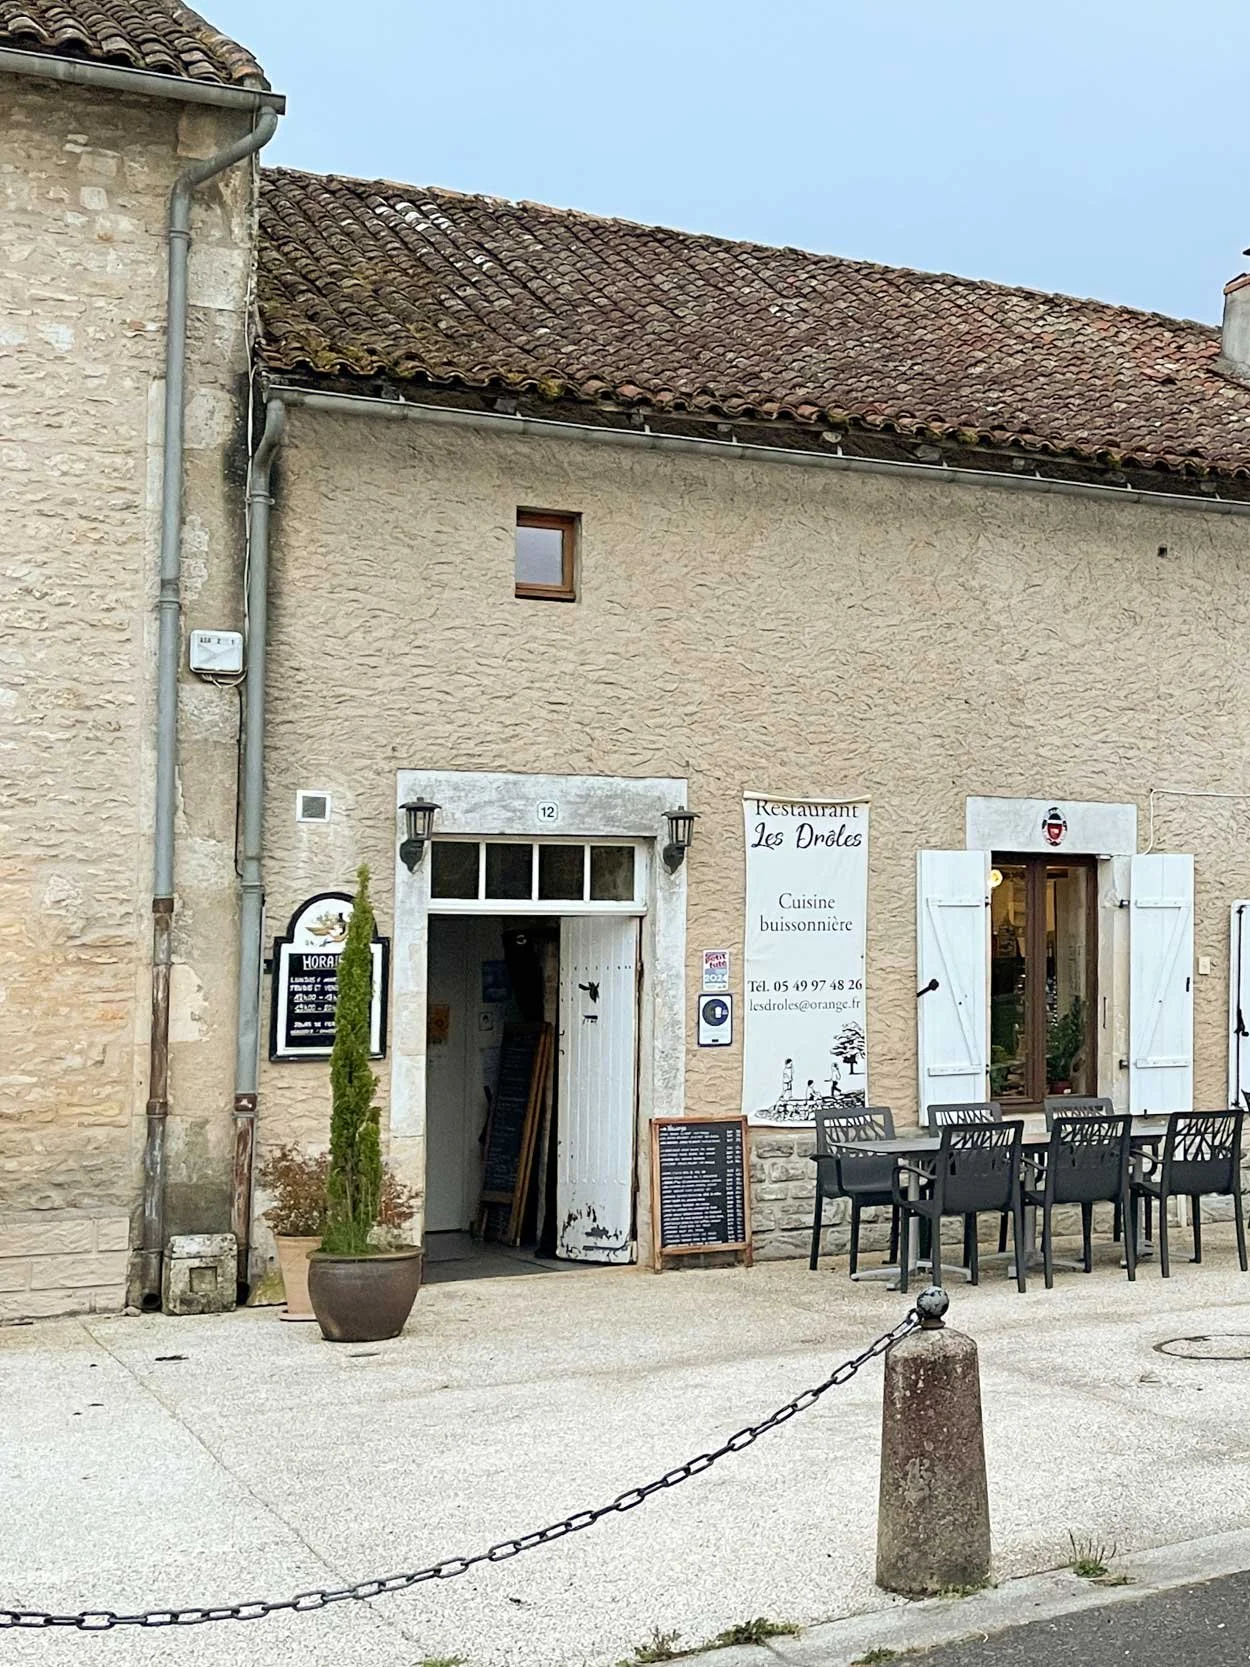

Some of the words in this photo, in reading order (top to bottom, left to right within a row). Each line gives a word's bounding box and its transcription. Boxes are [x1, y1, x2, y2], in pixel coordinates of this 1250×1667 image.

[541, 806, 555, 818] 12
[755, 799, 859, 818] Restaurant
[751, 822, 784, 850] Les
[796, 823, 863, 849] Drôles
[778, 892, 836, 909] Cuisine
[760, 914, 853, 932] buissonnière
[302, 955, 344, 969] HORAI
[747, 980, 770, 992] Tél.
[773, 980, 789, 992] 05
[792, 980, 808, 992] 49
[811, 980, 827, 991] 97
[829, 979, 845, 990] 48
[848, 979, 863, 990] 26
[749, 997, 861, 1013] lesdroles@orange.fr
